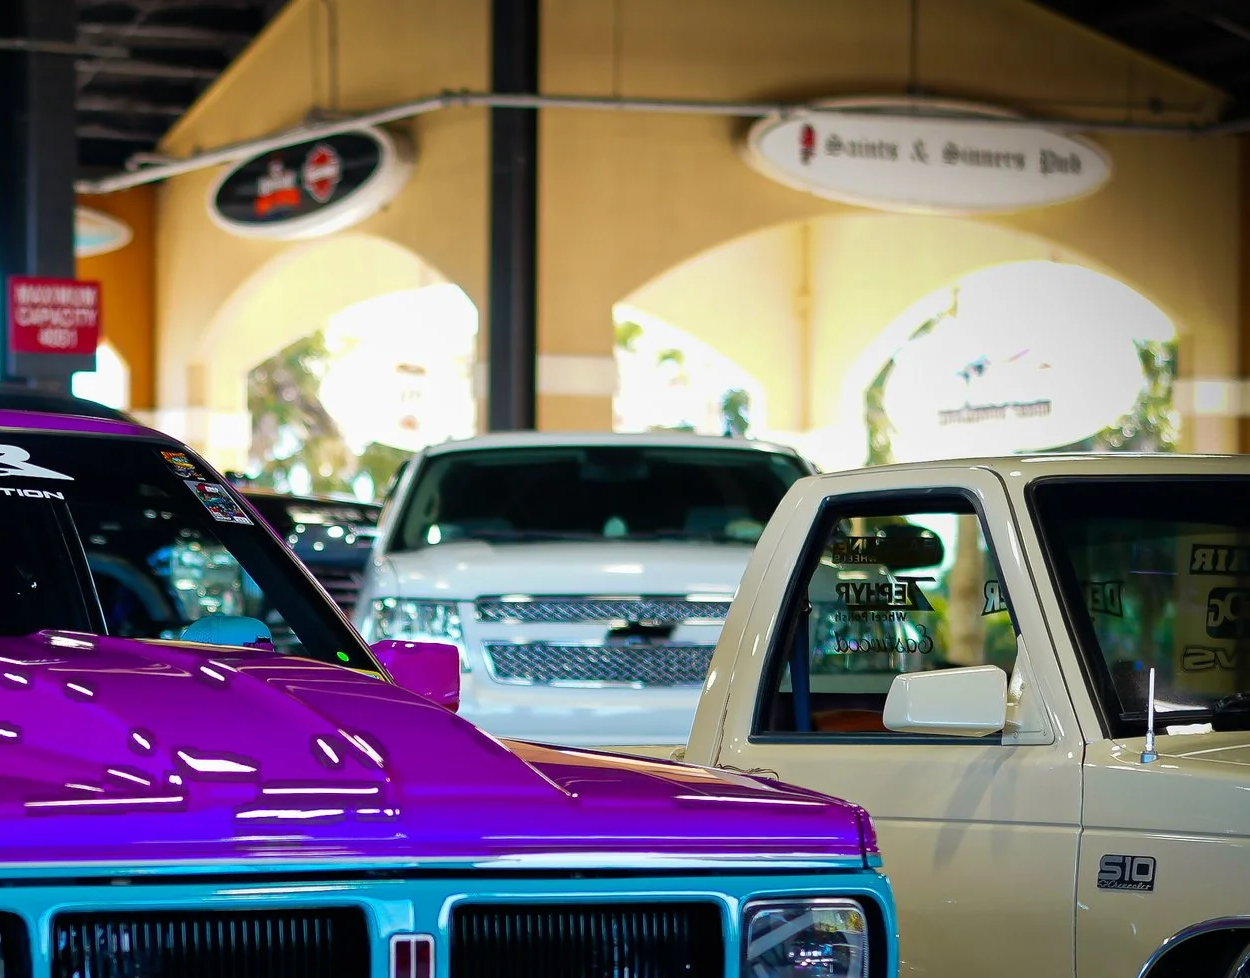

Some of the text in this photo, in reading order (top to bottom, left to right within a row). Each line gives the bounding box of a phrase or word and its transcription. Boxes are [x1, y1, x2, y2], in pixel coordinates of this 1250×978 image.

[825, 134, 1082, 175] Saints & Sinners Pub
[1098, 855, 1154, 882] S10
